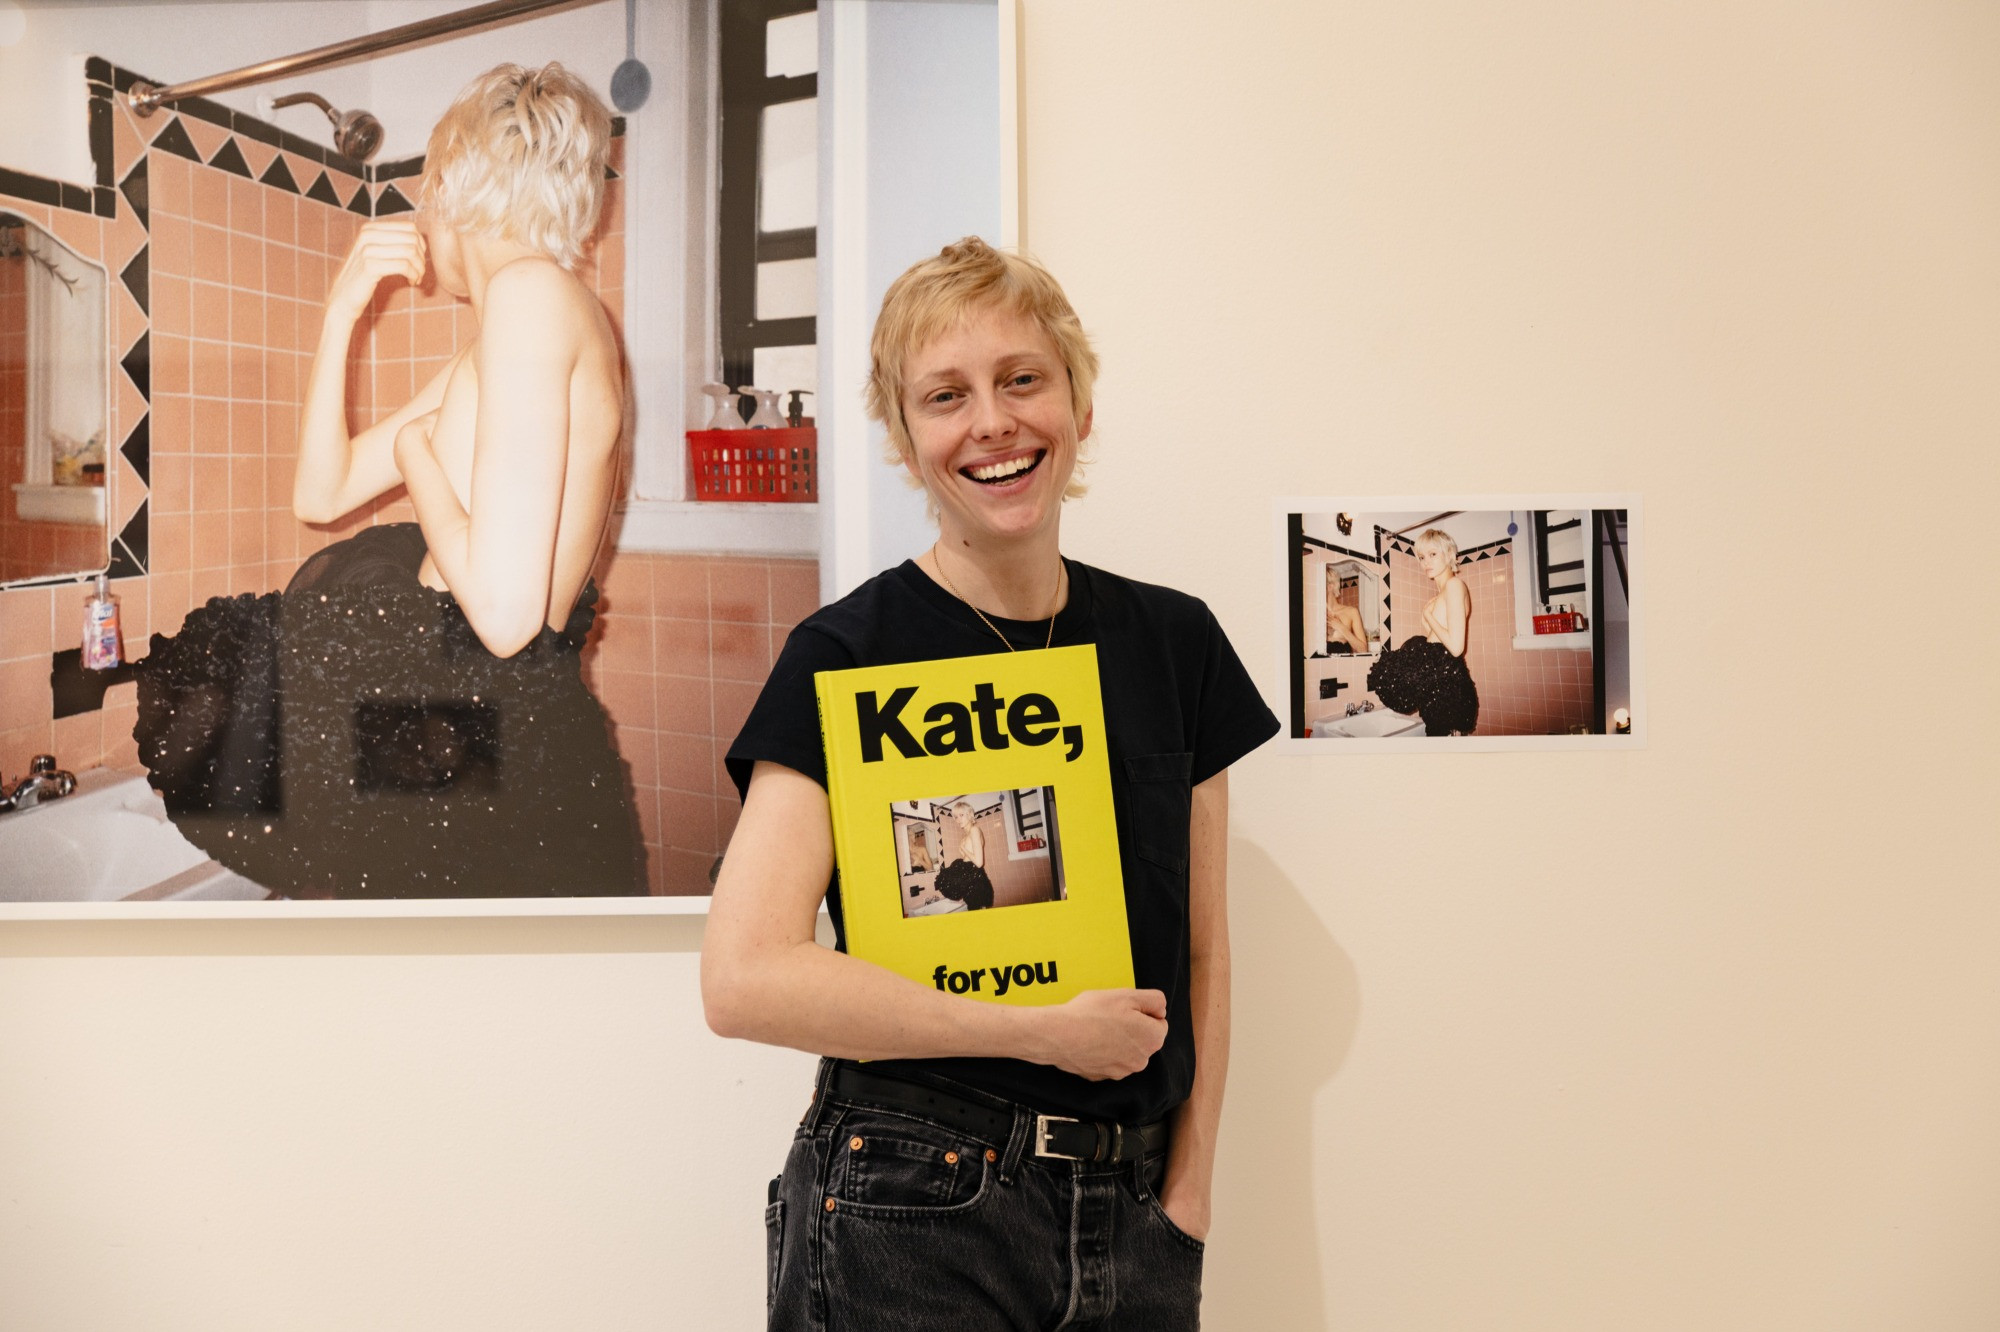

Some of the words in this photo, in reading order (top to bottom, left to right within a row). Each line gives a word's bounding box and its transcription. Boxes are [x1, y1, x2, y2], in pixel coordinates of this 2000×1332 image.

[855, 683, 1084, 763] Kate,
[932, 965, 986, 994] for
[990, 961, 1058, 996] you
